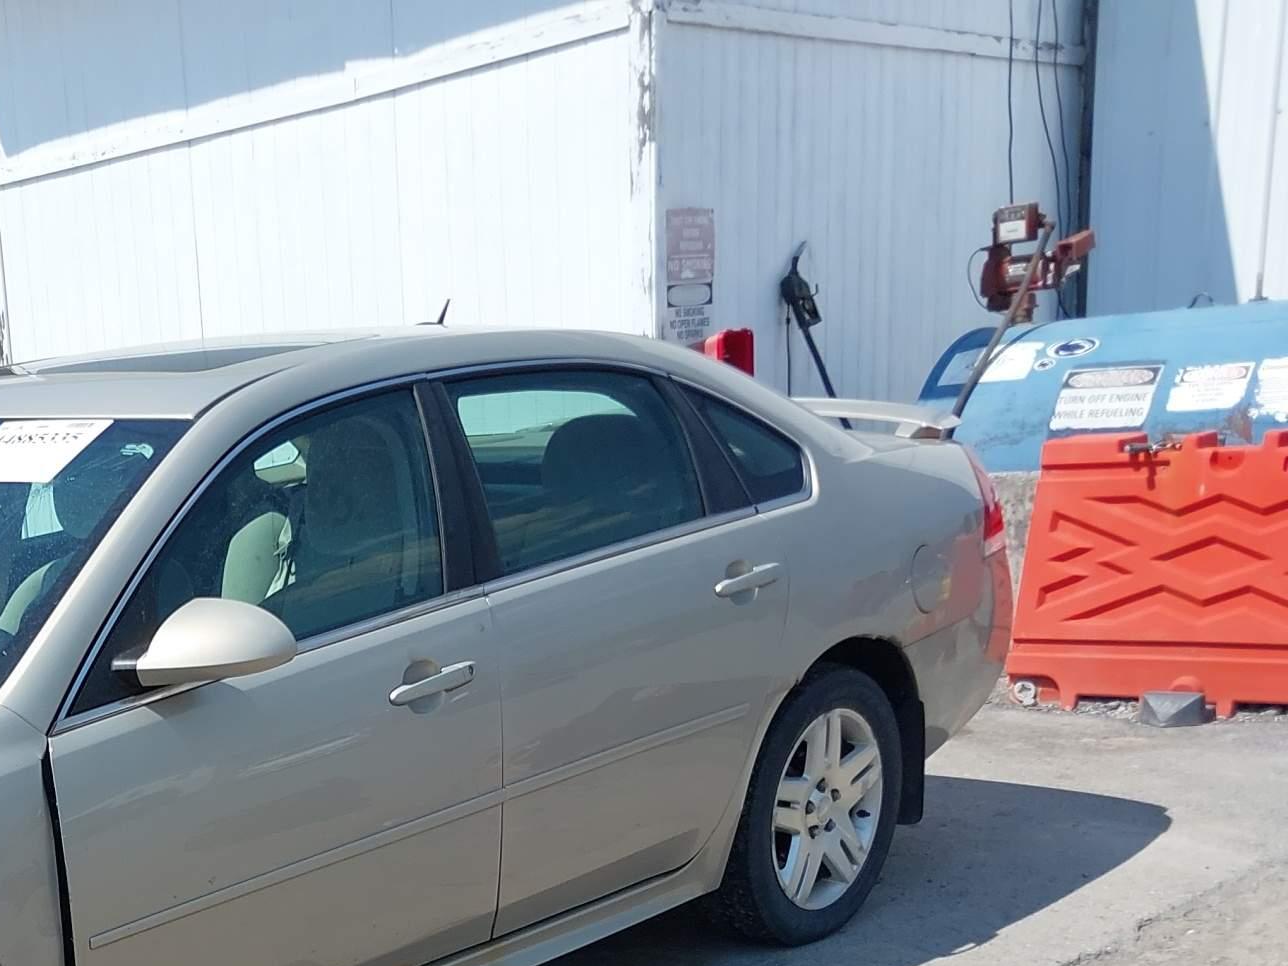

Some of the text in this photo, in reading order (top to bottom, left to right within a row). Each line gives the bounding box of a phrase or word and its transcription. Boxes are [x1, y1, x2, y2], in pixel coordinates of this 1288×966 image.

[1059, 391, 1148, 406] TURN OFF ENGINE
[1054, 406, 1145, 420] WHILE REFUELING
